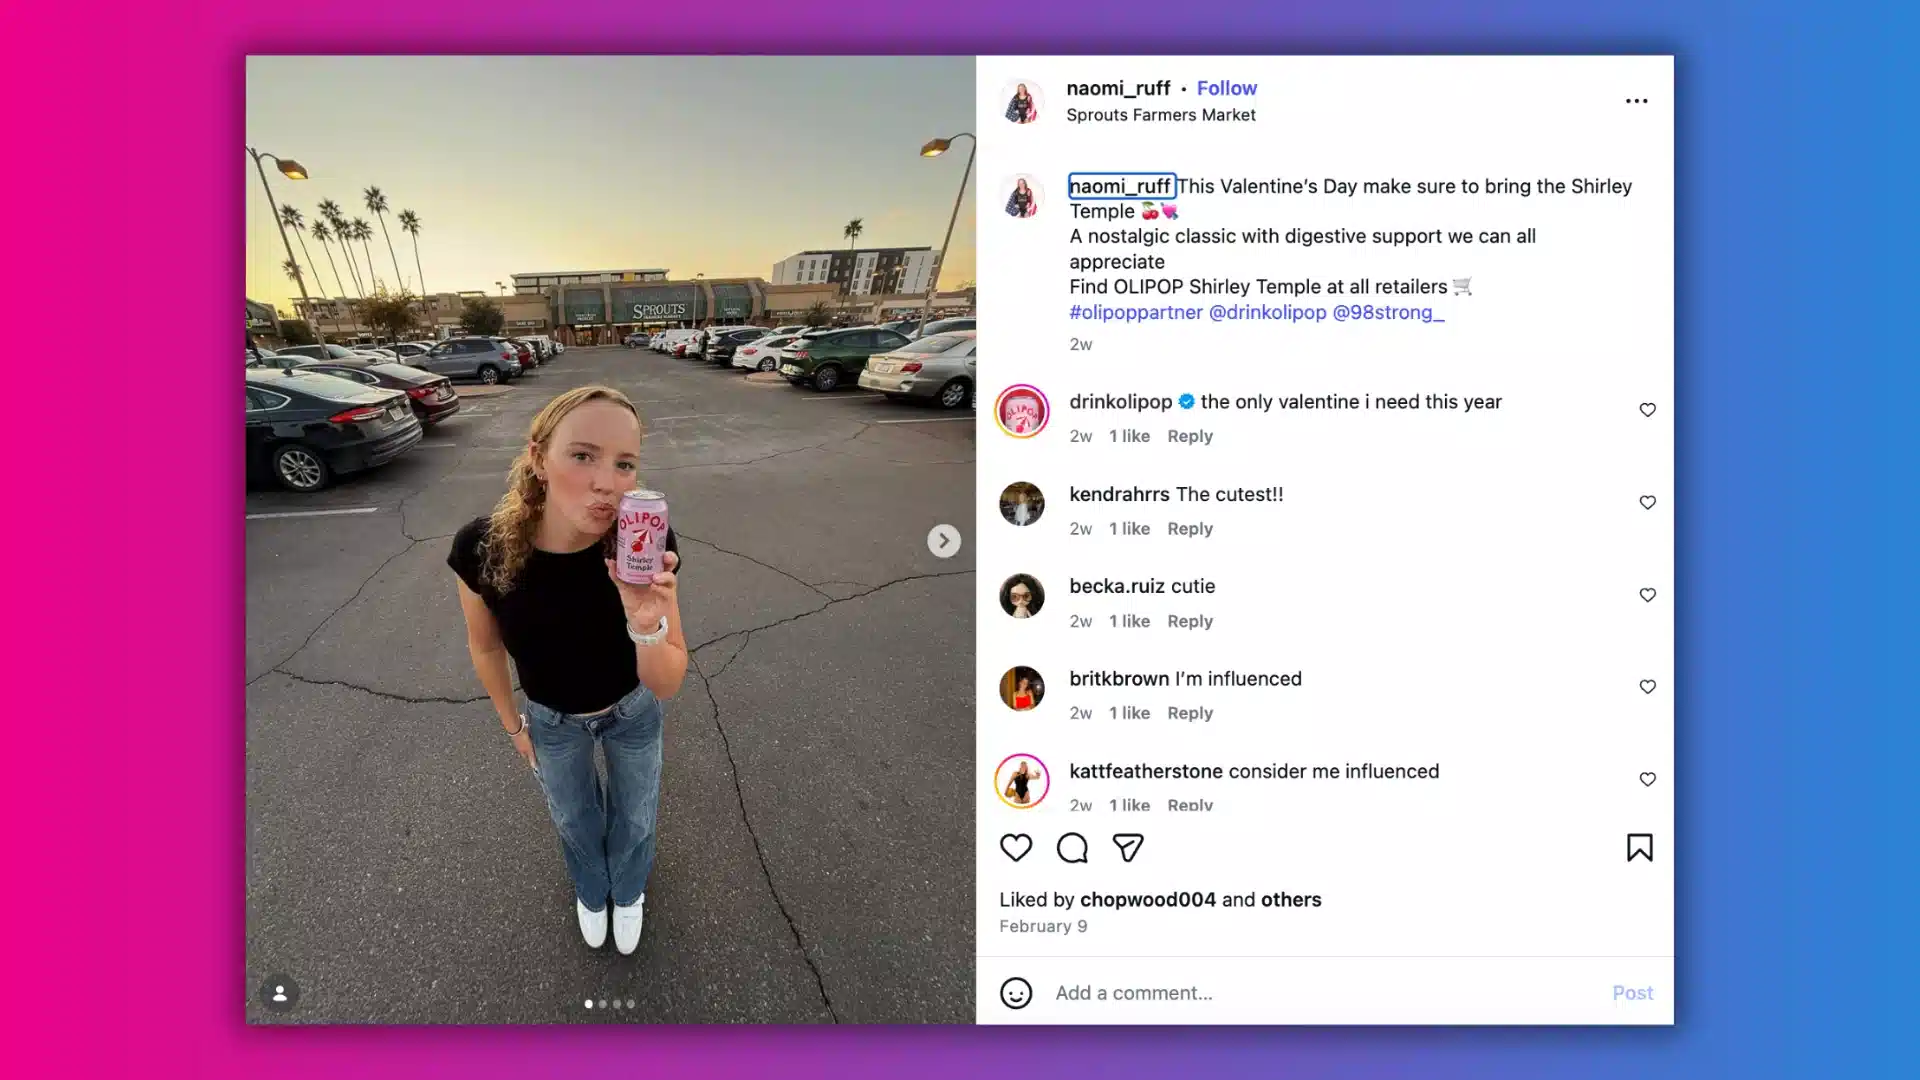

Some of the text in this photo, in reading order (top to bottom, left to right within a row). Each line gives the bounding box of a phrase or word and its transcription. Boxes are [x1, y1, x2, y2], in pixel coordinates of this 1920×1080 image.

[1067, 80, 1171, 99] naomi_ruff
[1197, 80, 1257, 97] Follow
[1067, 108, 1256, 125] Sprouts Farmers Market
[1070, 178, 1632, 198] naomi_ruff This Valentine’s Day make sure to bring the Shirley
[1070, 203, 1135, 222] Temple
[1070, 228, 1535, 247] A nostalgic classic with digestive support we can all
[1070, 254, 1164, 273] appreciate
[1071, 278, 1447, 297] Find OLIPOP Shirley Temple at all retailers
[633, 303, 686, 319] SPROUTS
[1070, 304, 1445, 323] #olipoppartner @drinkolipop @98strong_
[1071, 338, 1092, 351] 2w
[1070, 393, 1502, 413] drinkolipop the only valentine i need this year
[1071, 430, 1092, 442] 2w
[1110, 429, 1150, 442] 1 like
[1168, 429, 1213, 445] Reply
[1071, 486, 1283, 502] kendrahrrs The cutest!!
[619, 512, 665, 531] OLIPOP
[1071, 523, 1092, 535] 2w
[1110, 522, 1150, 535] 1 like
[1168, 522, 1213, 538] Reply
[626, 555, 654, 564] Shirley
[626, 562, 653, 572] Temple
[1071, 578, 1215, 593] becka.ruiz cutie
[1071, 615, 1092, 627] 2w
[1110, 614, 1150, 627] 1 like
[1168, 614, 1213, 630] Reply
[1071, 670, 1301, 686] britkbrown I’m influenced
[1071, 707, 1092, 719] 2w
[1110, 706, 1150, 719] 1 like
[1168, 706, 1213, 722] Reply
[1071, 763, 1439, 779] kattfeatherstone consider me influenced
[1071, 799, 1092, 812] 2w
[1110, 798, 1150, 812] 1 like
[1168, 798, 1213, 812] Reply
[1001, 891, 1321, 910] Liked by chopwood004 and others
[1001, 920, 1087, 936] February 9
[1056, 985, 1090, 1000] Add
[1098, 989, 1106, 1000] a
[1614, 985, 1653, 1000] Post
